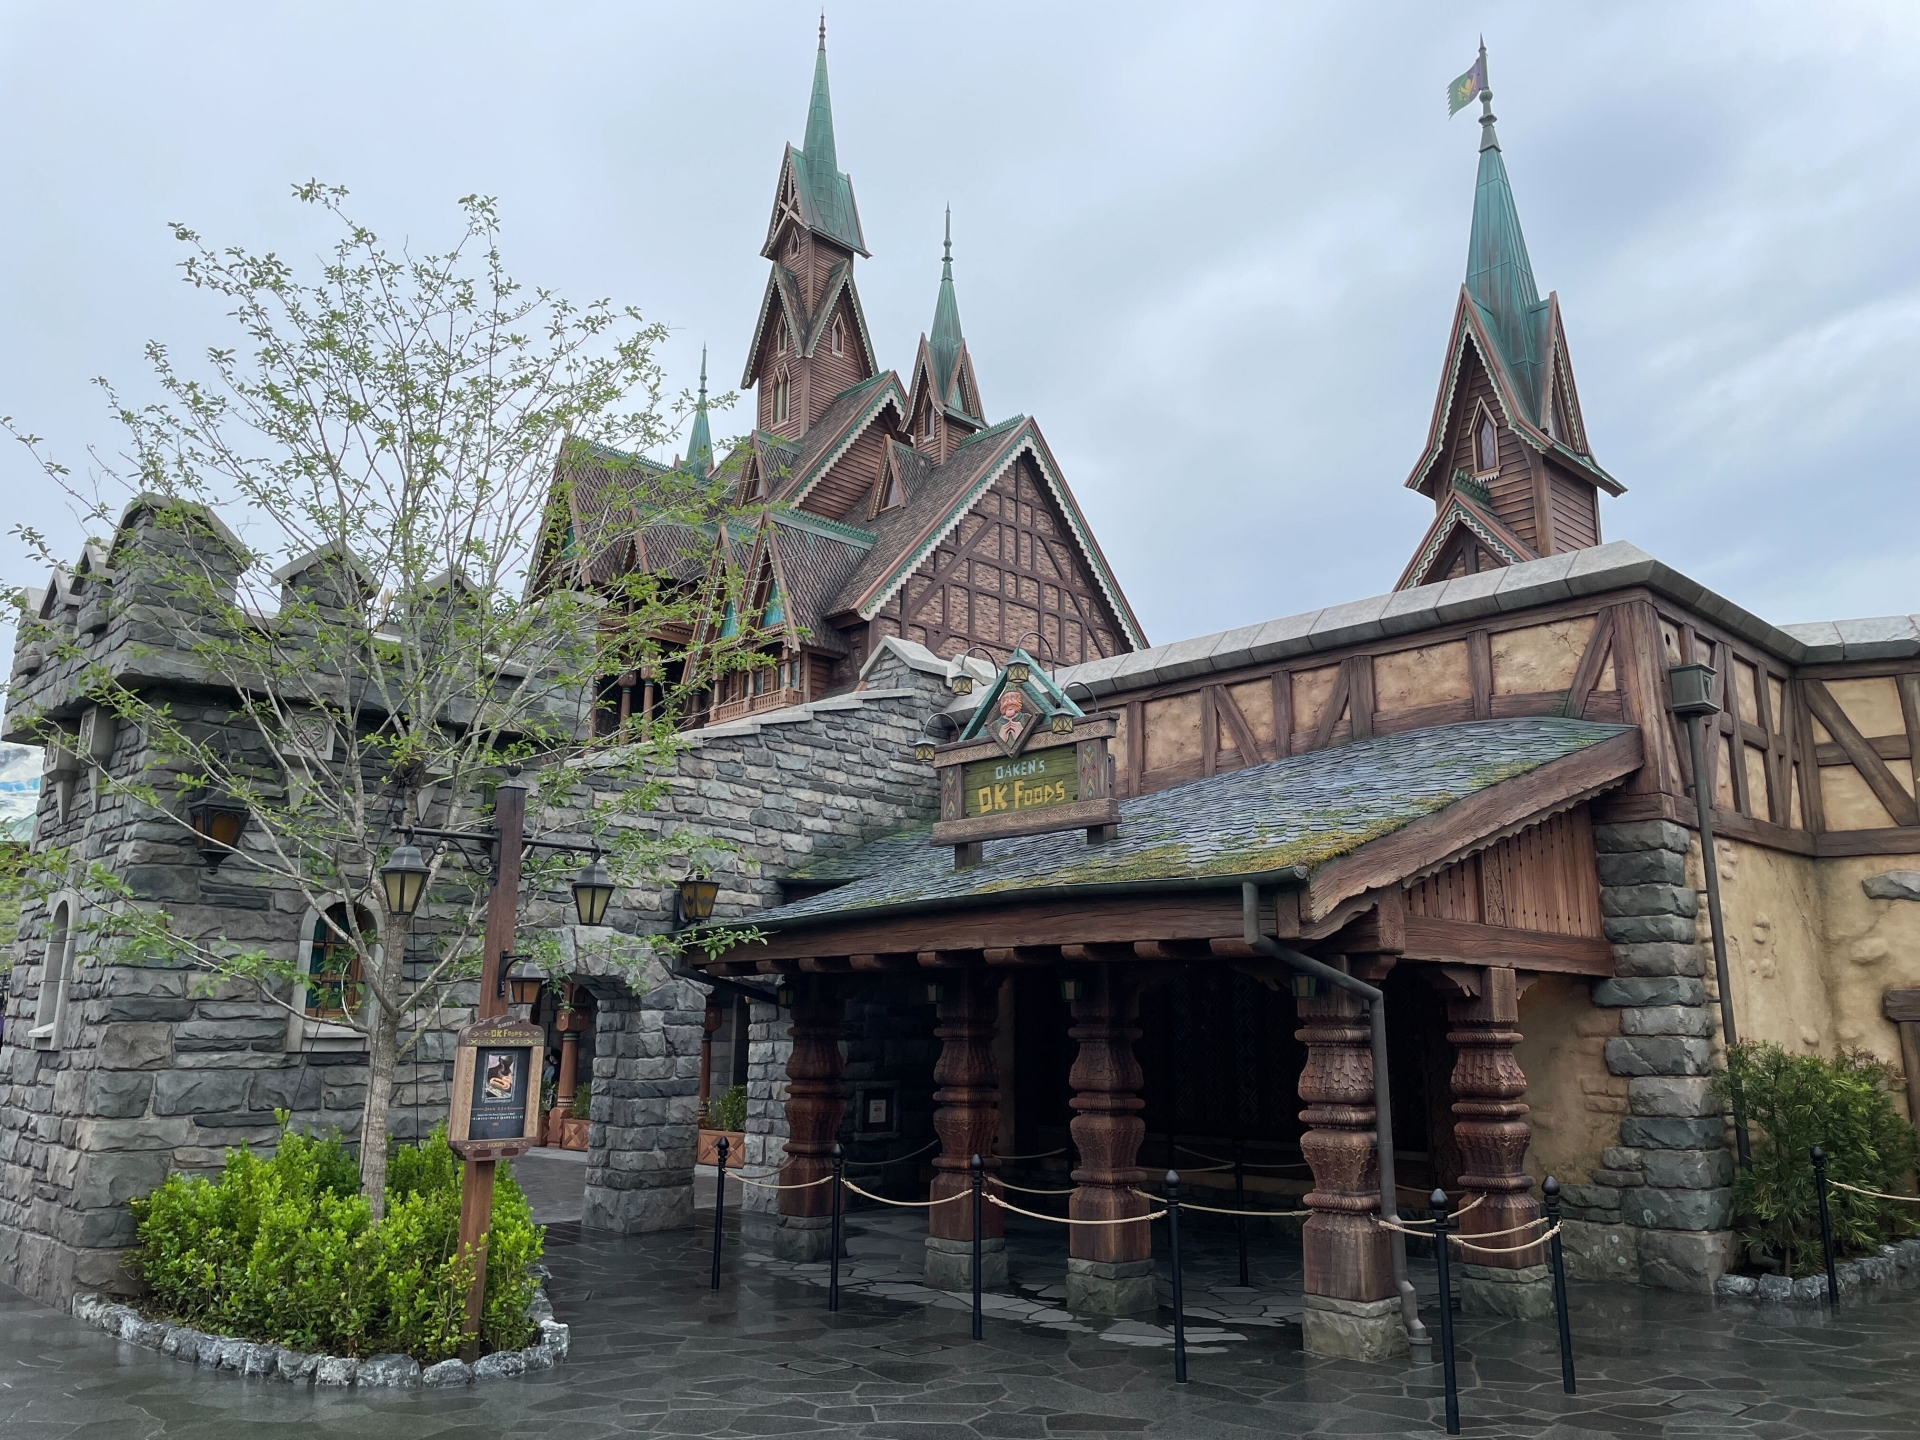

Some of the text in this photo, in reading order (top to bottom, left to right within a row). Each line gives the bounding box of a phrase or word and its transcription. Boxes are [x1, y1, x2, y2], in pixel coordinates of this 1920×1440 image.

[995, 758, 1045, 780] OAKEN'S
[978, 779, 1066, 814] OK FOODS
[491, 1029, 503, 1038] OK
